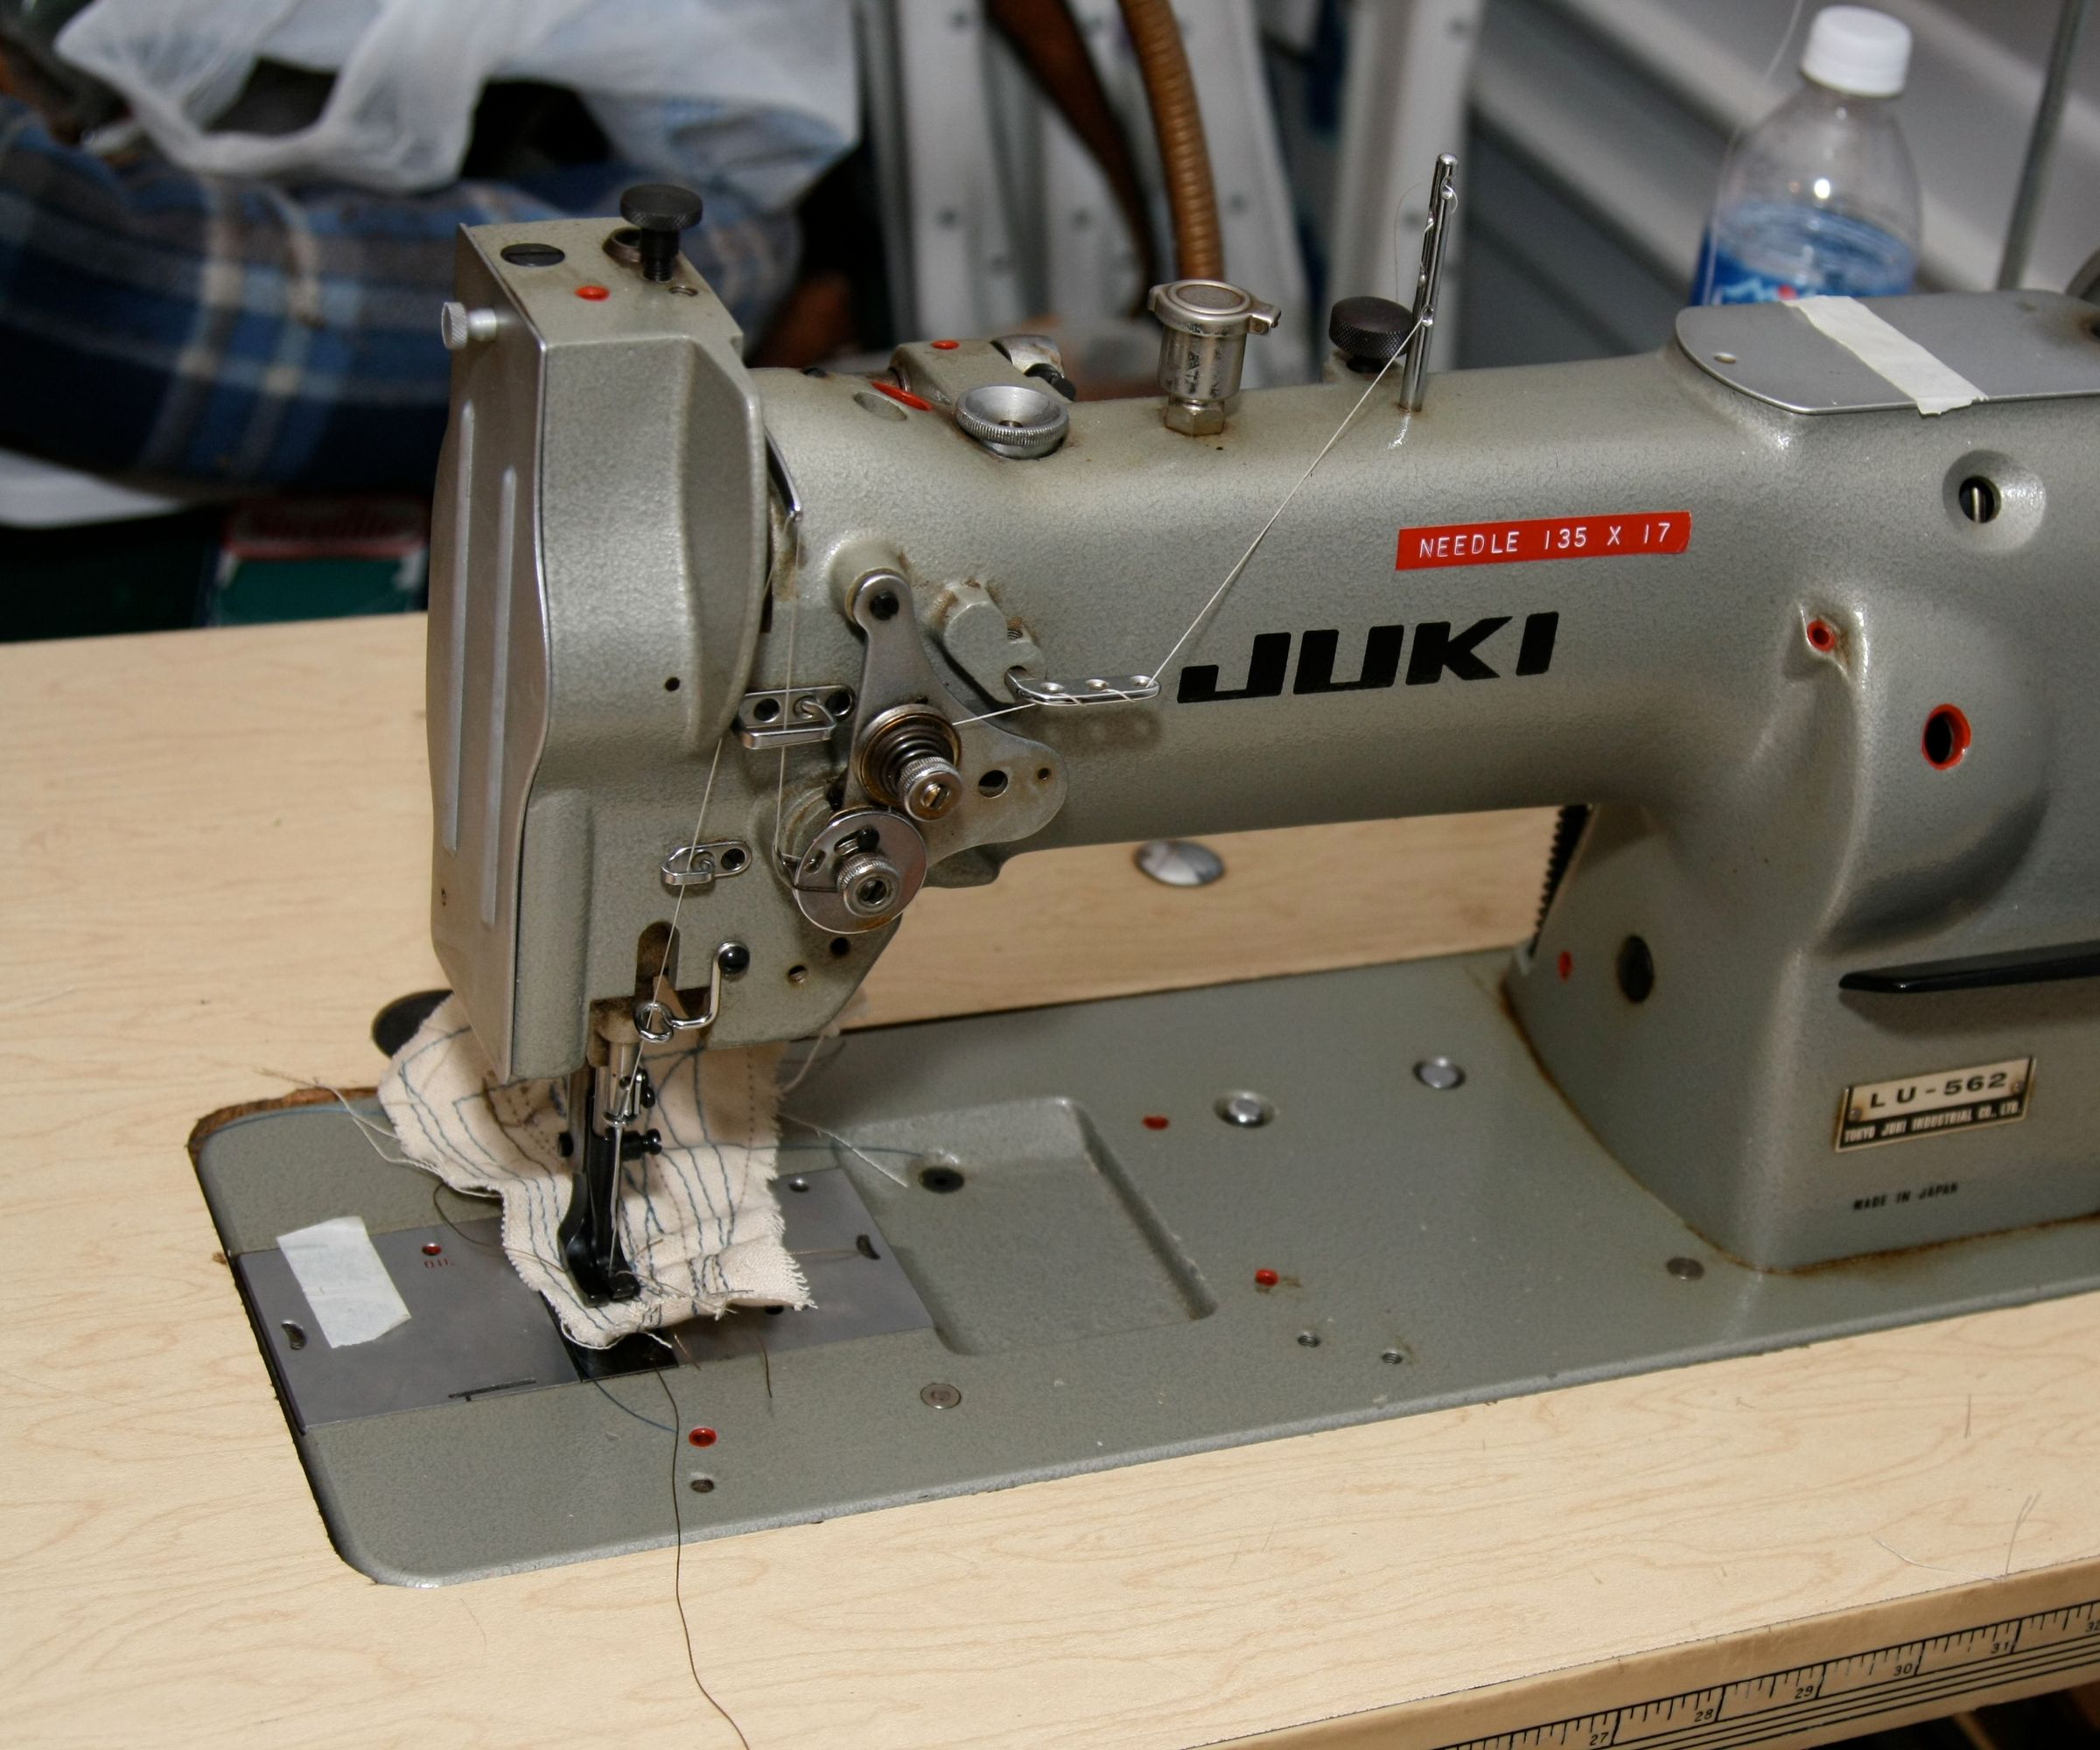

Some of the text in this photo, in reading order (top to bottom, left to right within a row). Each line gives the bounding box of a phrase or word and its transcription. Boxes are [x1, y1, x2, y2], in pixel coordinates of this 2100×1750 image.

[1418, 522, 1672, 558] NEEDLE 135 X 17
[1177, 611, 1560, 704] JUKI
[1870, 1072, 2008, 1109] LU-562
[1852, 1182, 1959, 1211] MADE IN JAPAN
[1991, 1641, 2010, 1654] 31
[1893, 1663, 1914, 1677] 30
[1794, 1685, 1815, 1699] 29
[1693, 1707, 1714, 1723] 28
[1589, 1732, 1610, 1746] 27
